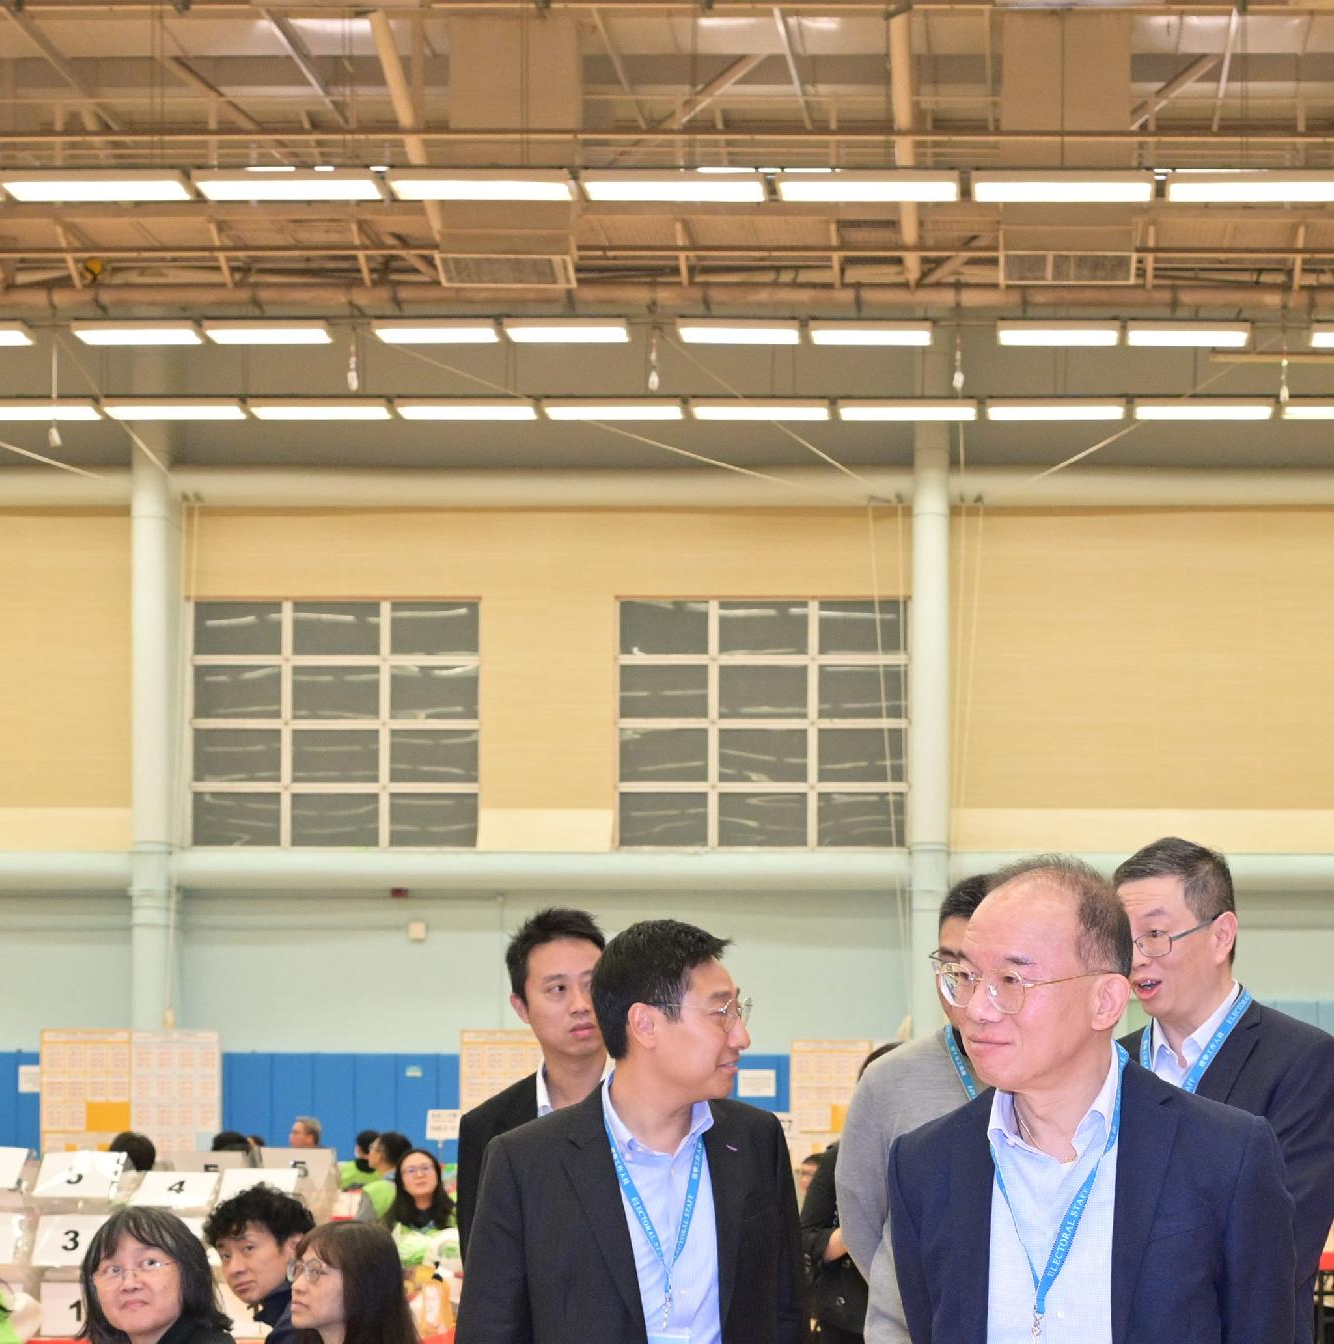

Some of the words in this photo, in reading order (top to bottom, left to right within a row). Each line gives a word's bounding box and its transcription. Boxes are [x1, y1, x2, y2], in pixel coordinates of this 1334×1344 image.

[167, 1180, 186, 1195] 4
[631, 1196, 657, 1241] ELECTORAL
[61, 1229, 80, 1252] 3
[1046, 1220, 1076, 1278] ELECTORAL
